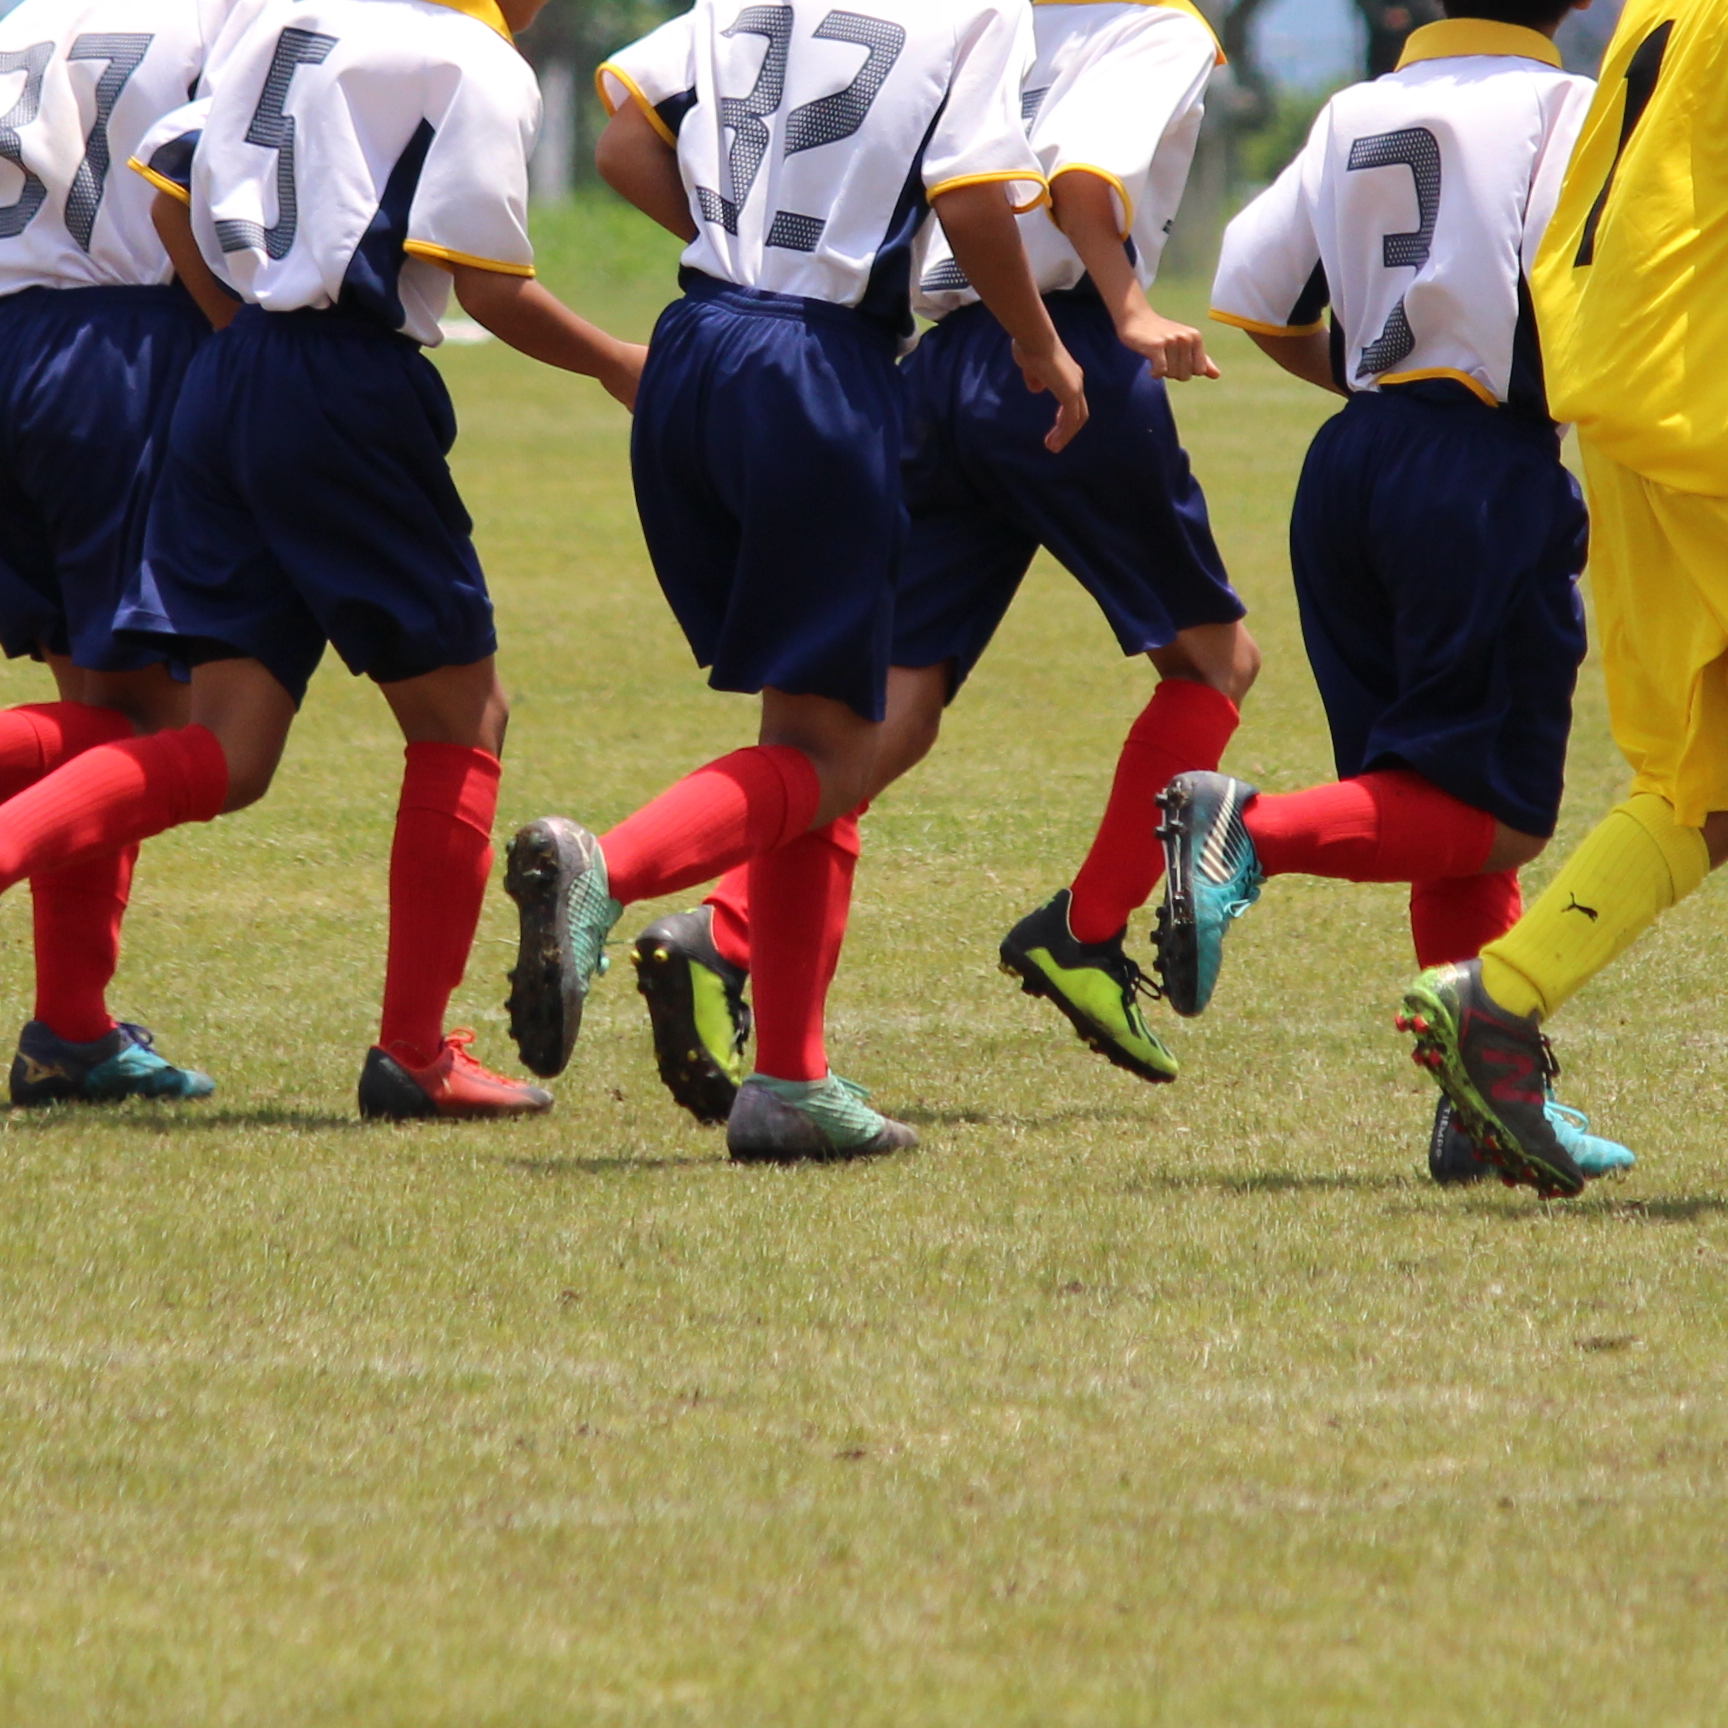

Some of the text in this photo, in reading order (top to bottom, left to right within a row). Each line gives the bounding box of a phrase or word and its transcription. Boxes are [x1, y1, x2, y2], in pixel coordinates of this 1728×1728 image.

[214, 27, 339, 261] 5
[697, 4, 905, 252] 32
[1573, 19, 1676, 267] 1
[1348, 128, 1442, 380] 3
